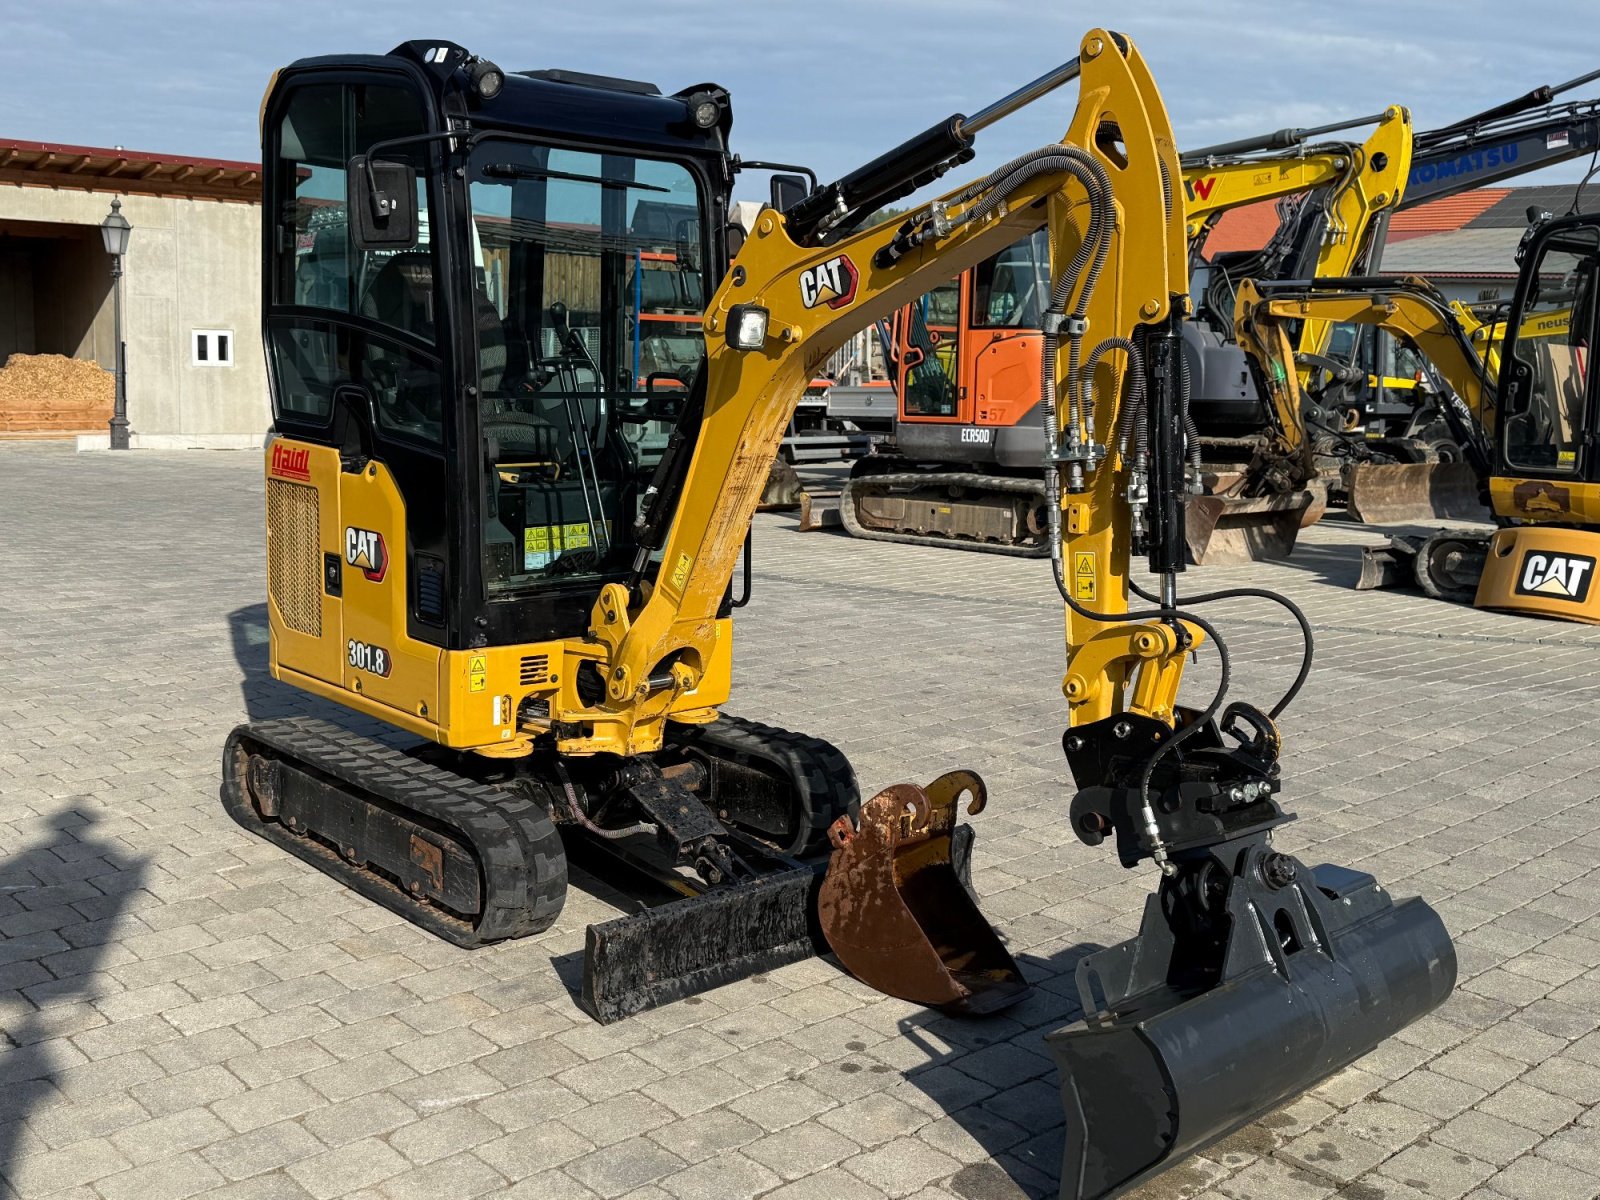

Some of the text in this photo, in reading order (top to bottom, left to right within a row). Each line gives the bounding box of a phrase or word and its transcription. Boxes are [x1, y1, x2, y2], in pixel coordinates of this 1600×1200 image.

[1408, 144, 1519, 186] KOMATSU
[800, 257, 844, 308] CAT
[989, 408, 1006, 421] 57
[1451, 392, 1473, 421] TERE
[961, 428, 990, 443] ECR50D
[272, 444, 311, 474] Haidl
[346, 527, 378, 569] CAT
[1522, 554, 1591, 597] CAT
[348, 640, 384, 675] 301.8
